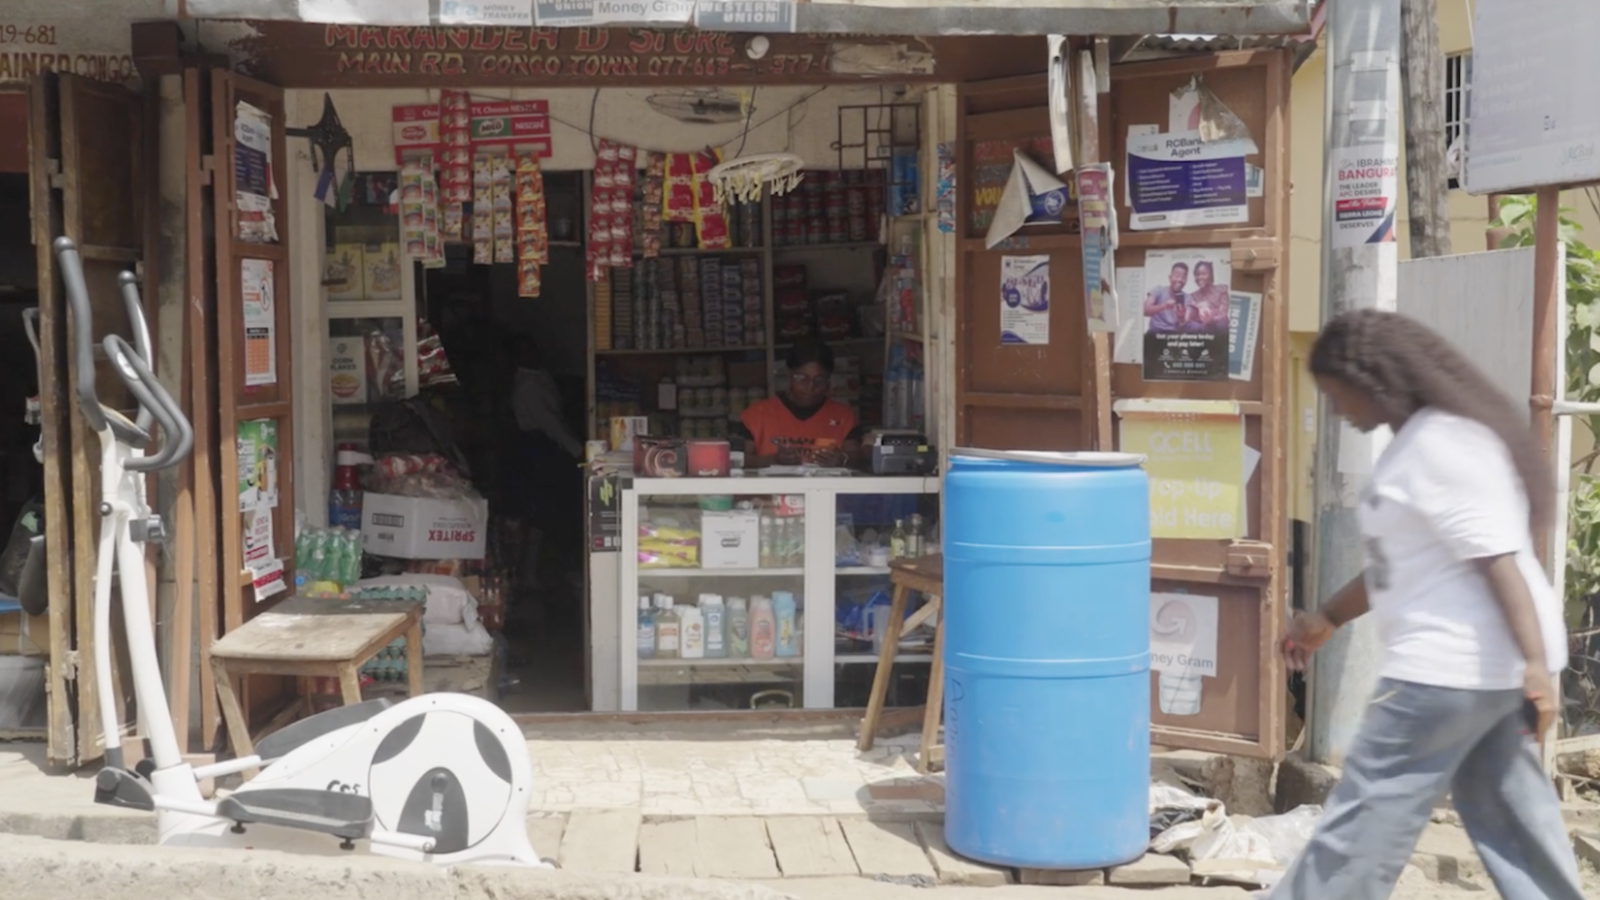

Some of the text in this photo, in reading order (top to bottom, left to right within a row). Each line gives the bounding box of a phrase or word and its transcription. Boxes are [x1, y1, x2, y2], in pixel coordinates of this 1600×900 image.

[554, 1, 594, 11] UNION
[598, 2, 649, 16] Money
[700, 2, 778, 12] WESTERN
[723, 12, 777, 23] UNION
[0, 25, 57, 45] 19-681
[74, 54, 132, 82] CONGO
[338, 52, 411, 74] MAIN
[480, 55, 562, 75] CONGO
[571, 56, 638, 77] TOWN
[482, 121, 503, 132] MILO
[1165, 137, 1206, 149] RCBank
[1170, 147, 1202, 158] Agent
[1338, 167, 1395, 181] BANGURA
[1352, 182, 1378, 190] LEADER
[1339, 221, 1375, 230] DESERVES
[1247, 301, 1259, 341] TRANSFER
[1228, 306, 1242, 354] UNION
[1150, 431, 1214, 453] QCELL
[1184, 508, 1232, 528] Here
[428, 530, 476, 542] SPRITEX
[1177, 654, 1214, 668] Gram
